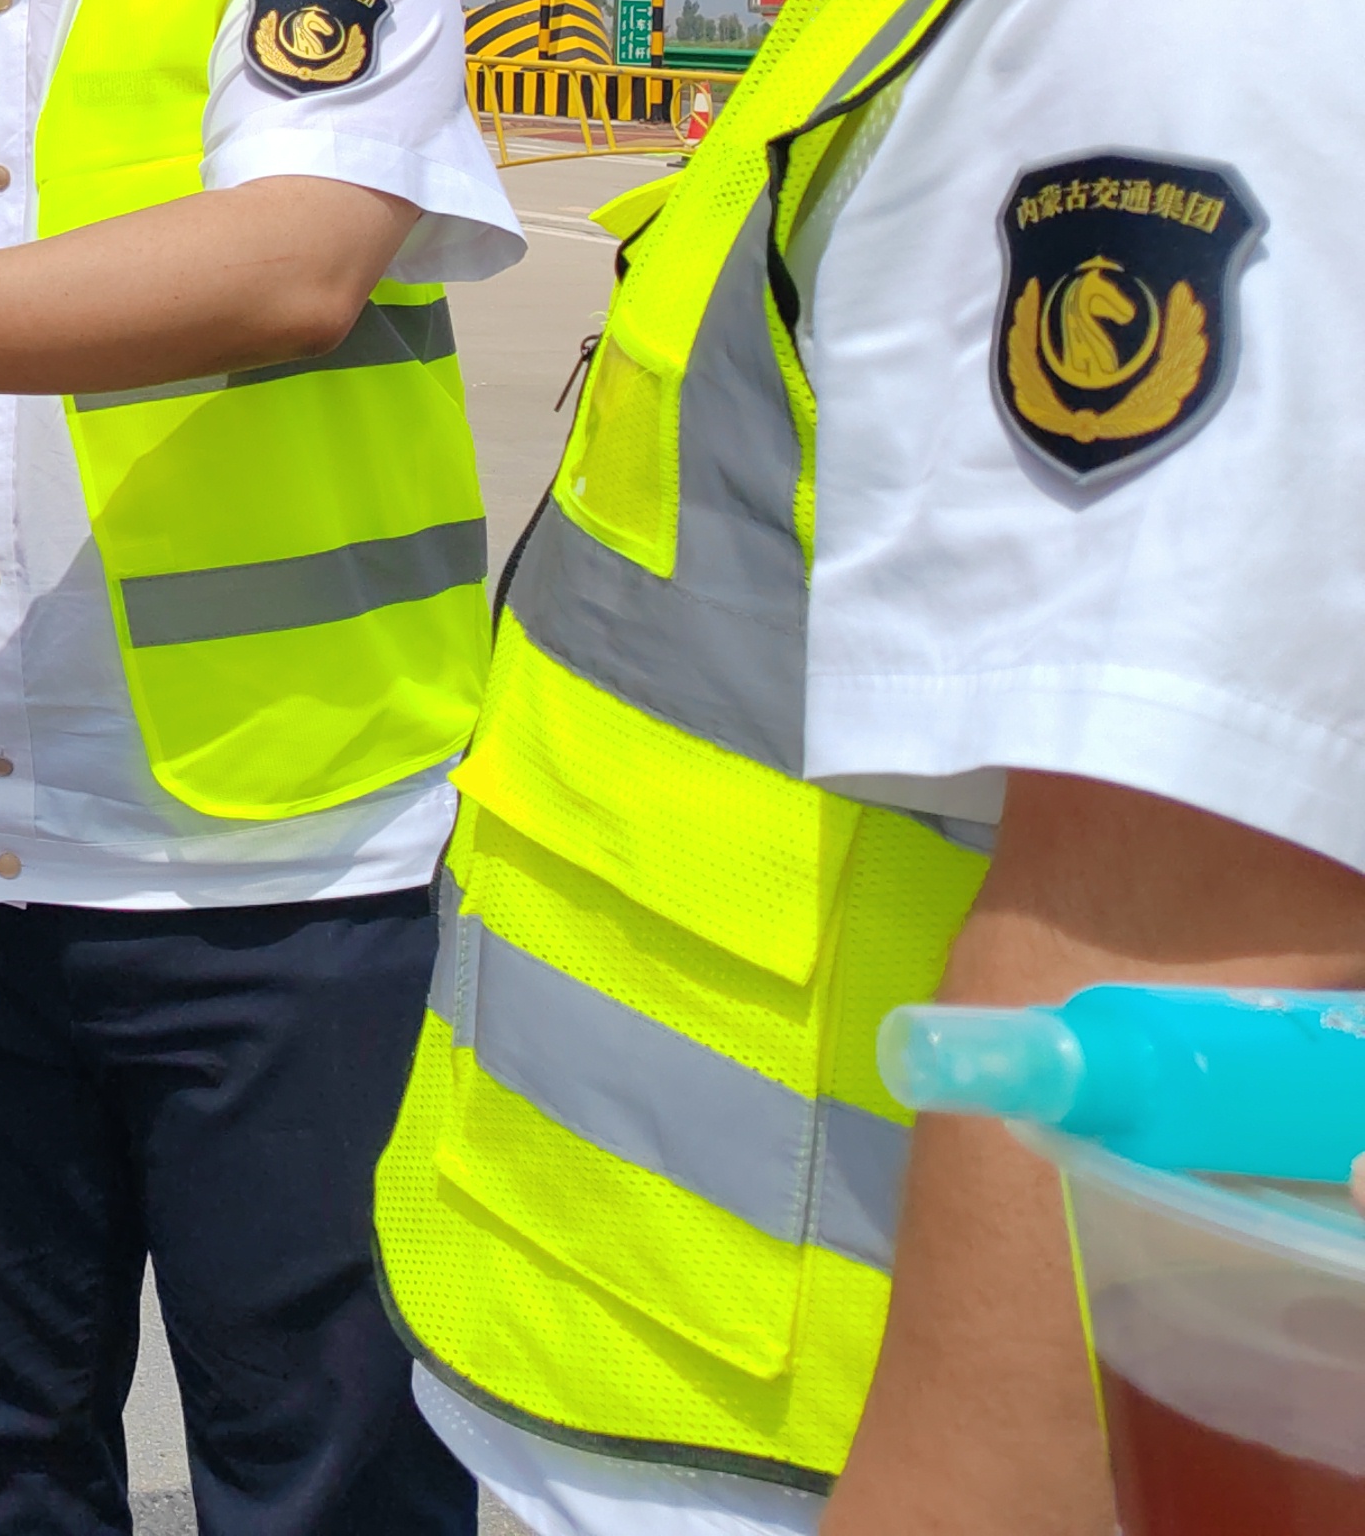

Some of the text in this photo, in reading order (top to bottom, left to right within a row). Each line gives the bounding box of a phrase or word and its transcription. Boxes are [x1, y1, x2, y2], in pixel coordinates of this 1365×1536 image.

[1017, 177, 1225, 235] 内蒙古交通集团
